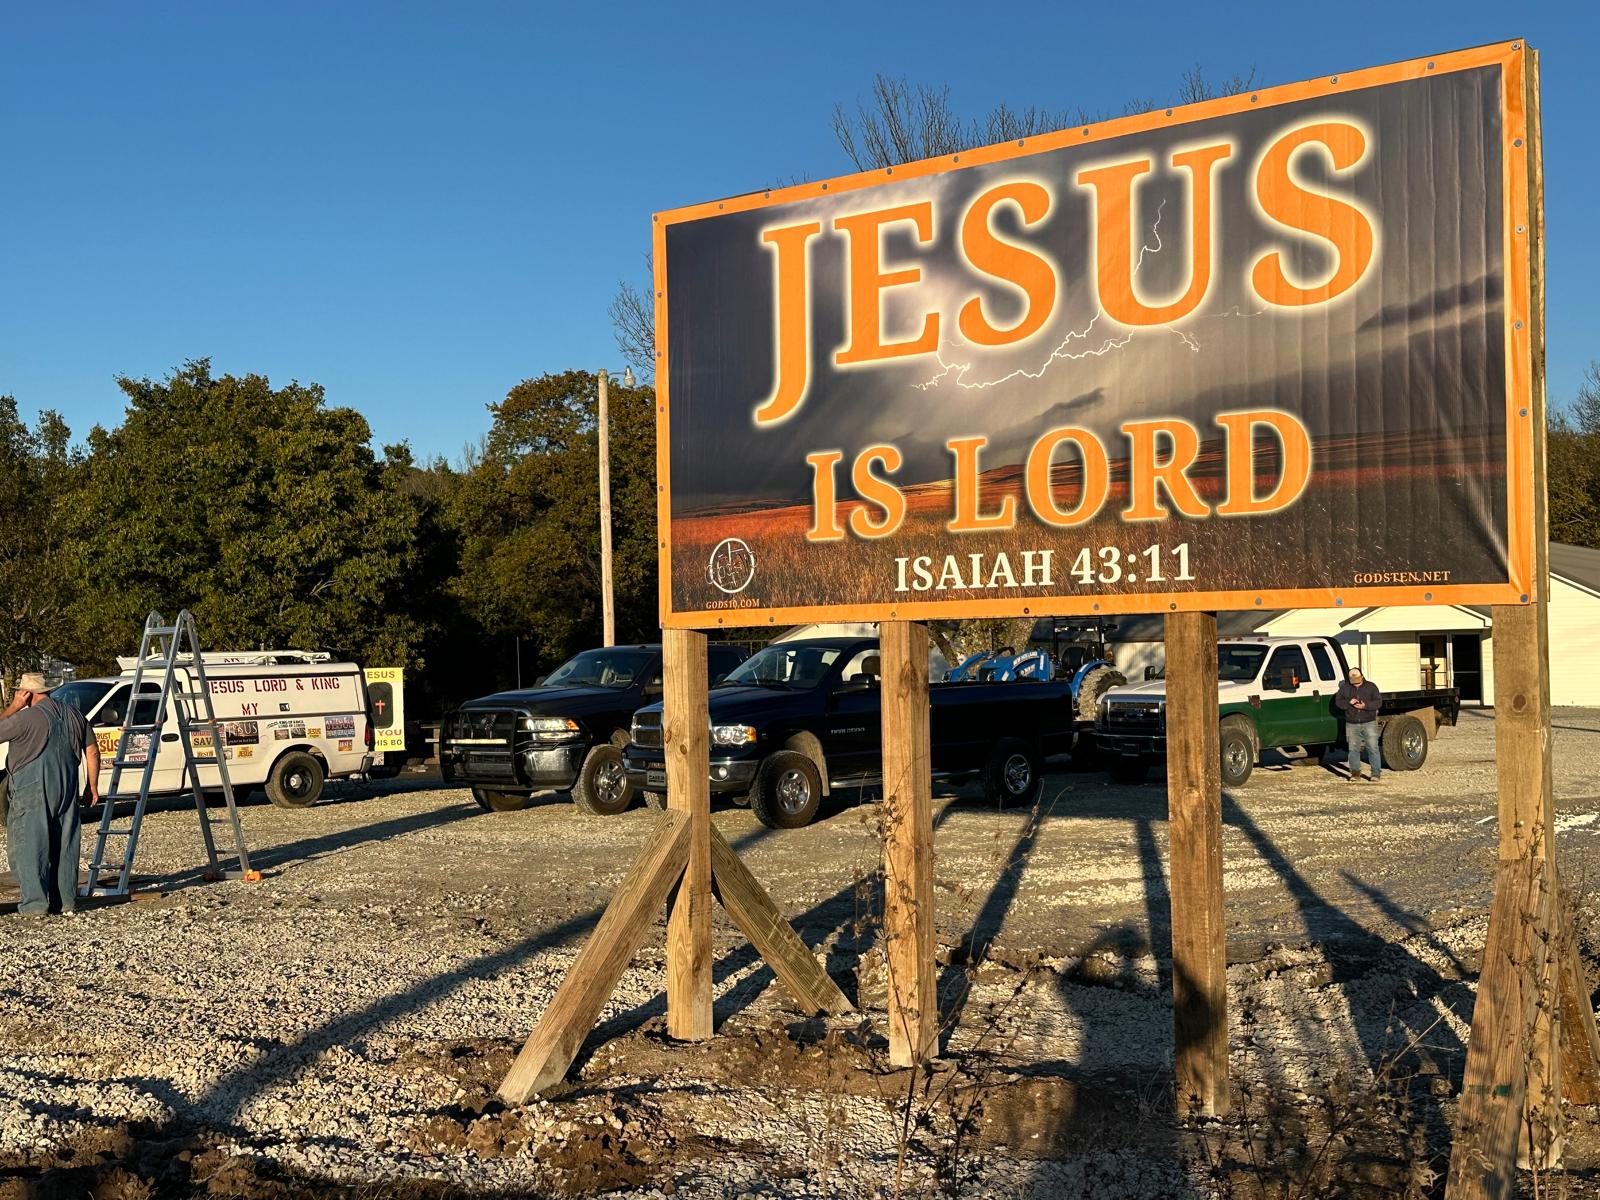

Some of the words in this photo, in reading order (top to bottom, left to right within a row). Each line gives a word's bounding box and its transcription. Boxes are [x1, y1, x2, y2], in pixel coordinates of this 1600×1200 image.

[753, 119, 1378, 427] JESUS
[806, 443, 905, 541] IS
[945, 409, 1312, 533] LORD
[894, 549, 1055, 592] ISAIAH
[1070, 542, 1196, 585] 43:11
[1353, 570, 1451, 584] GODSTEN.NET
[705, 598, 760, 609] GODS10.COM
[367, 671, 396, 679] ESUS
[254, 679, 288, 693] LORD
[295, 678, 305, 691] &
[311, 677, 340, 691] KING
[241, 702, 258, 716] MY
[96, 732, 111, 740] RUST
[377, 729, 402, 737] YOU
[97, 739, 121, 752] SUS
[193, 736, 212, 746] SAV
